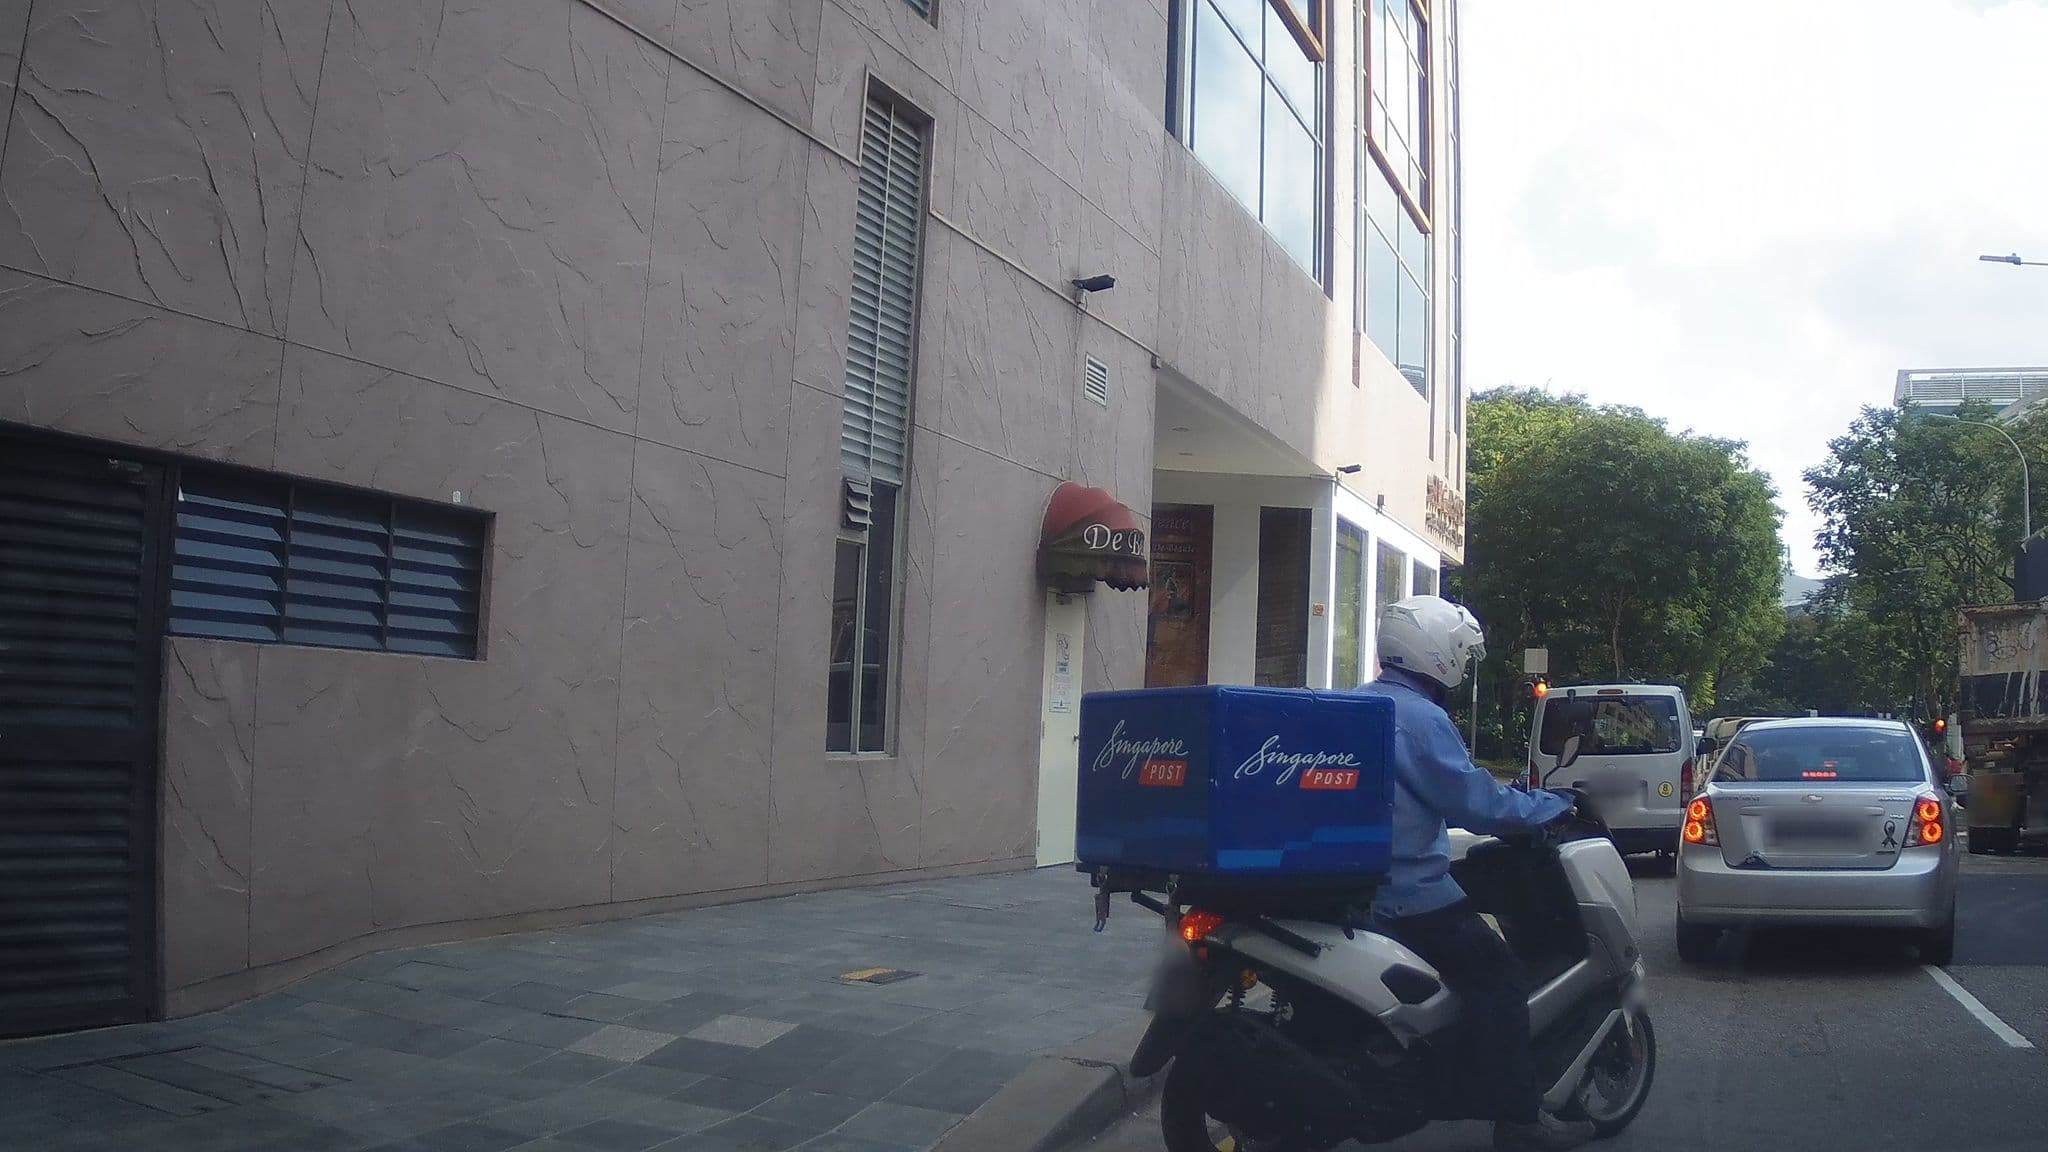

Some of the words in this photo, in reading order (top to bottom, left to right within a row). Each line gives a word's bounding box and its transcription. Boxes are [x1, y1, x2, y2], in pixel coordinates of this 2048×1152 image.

[1083, 523, 1123, 551] De
[1128, 529, 1145, 556] B
[1092, 719, 1190, 780] Singapore
[1233, 735, 1362, 785] Singapore
[1150, 764, 1184, 780] POST
[1313, 772, 1355, 785] POST
